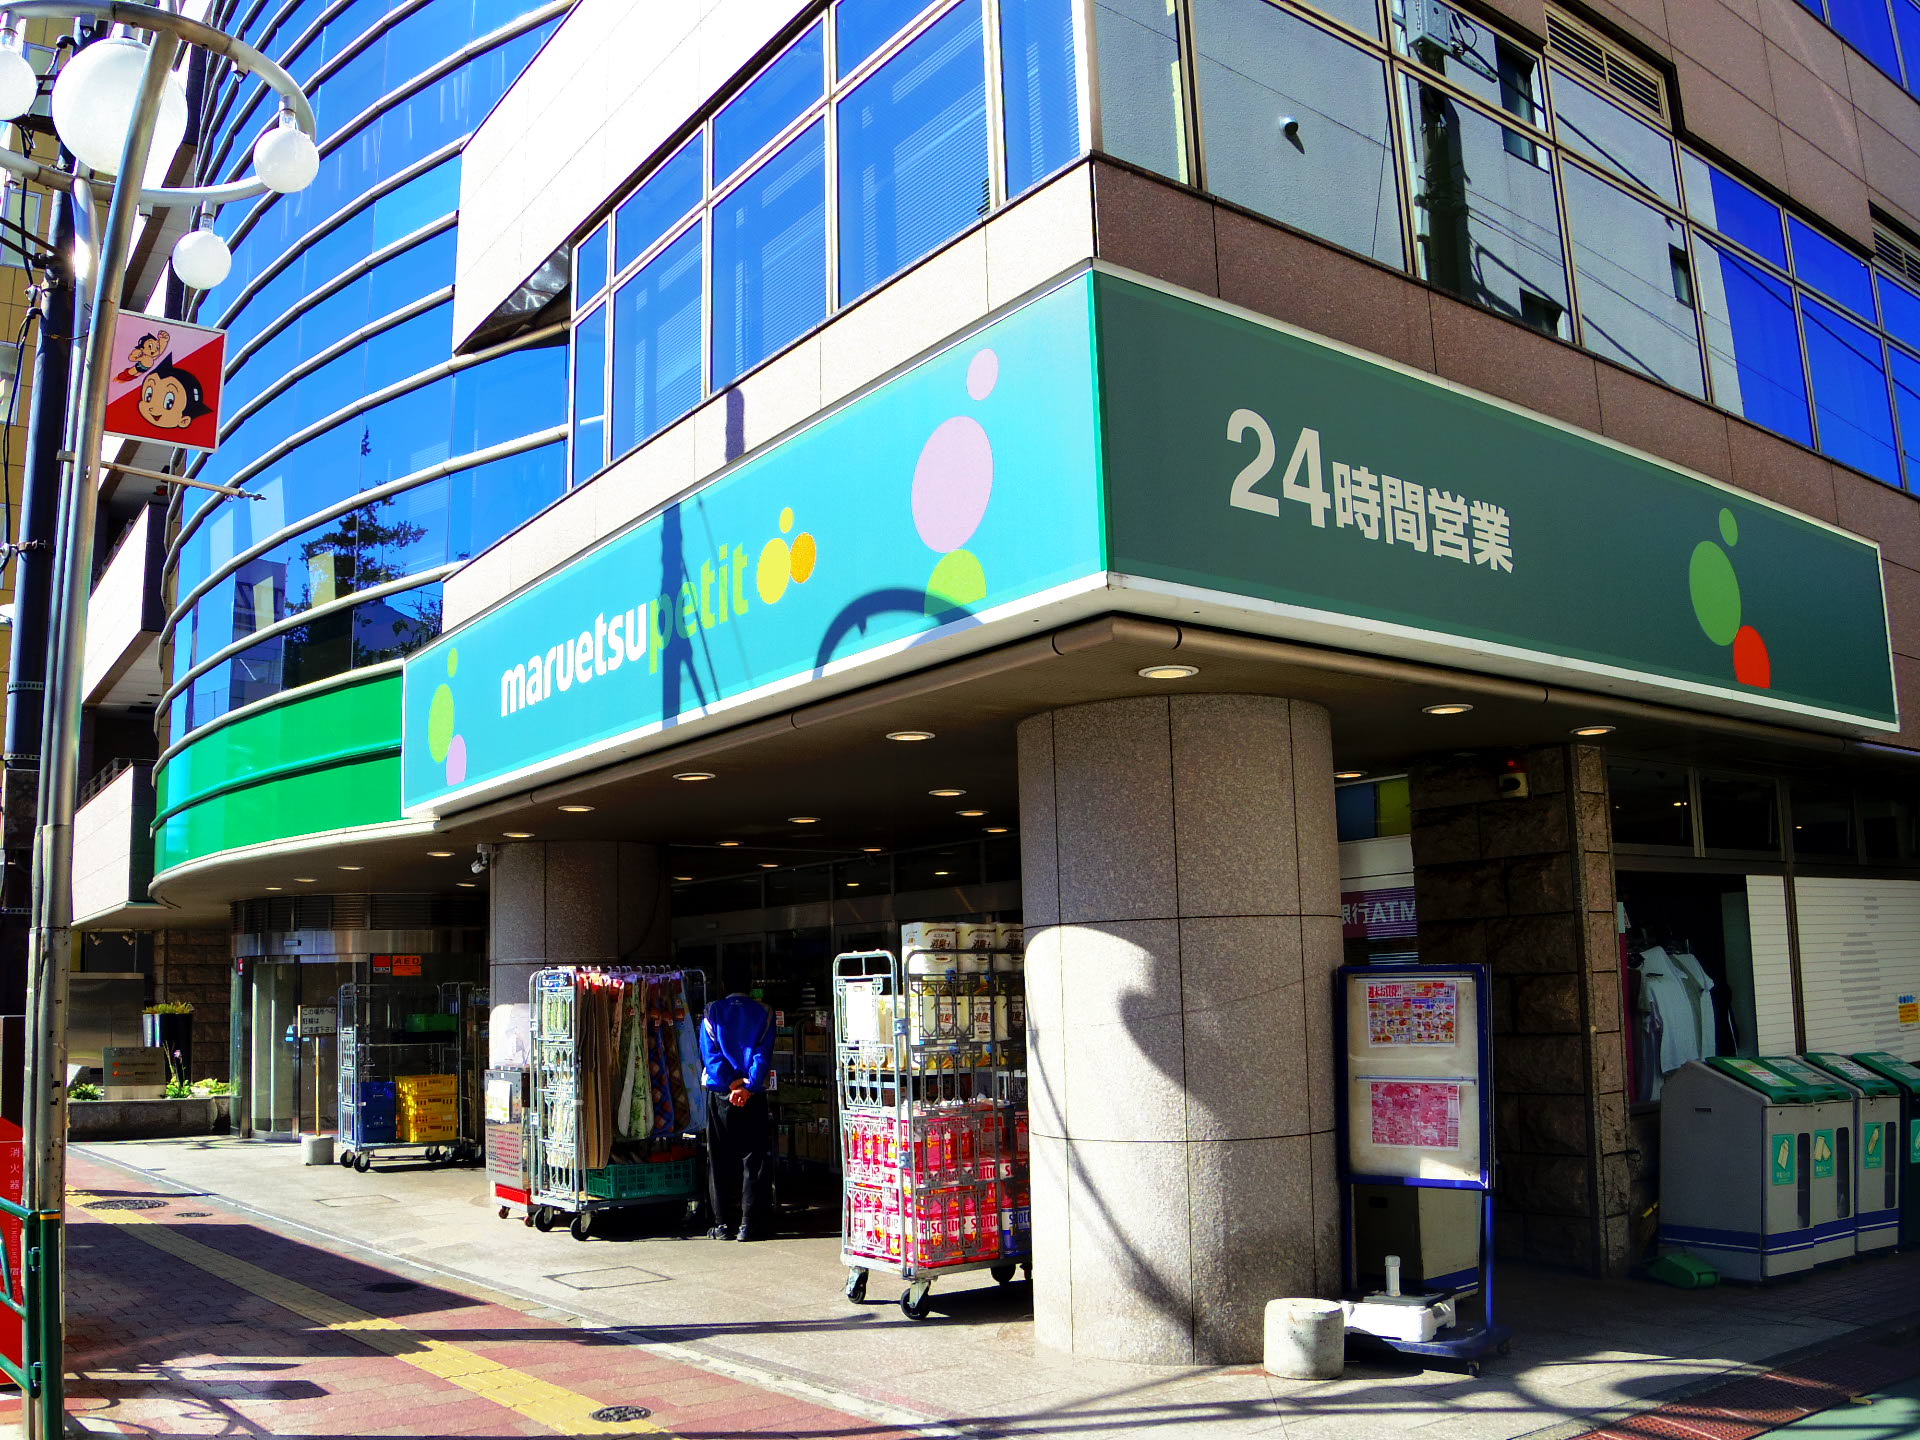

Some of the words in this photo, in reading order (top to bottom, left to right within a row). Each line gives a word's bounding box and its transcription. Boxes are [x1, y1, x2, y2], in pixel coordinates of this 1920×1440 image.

[1226, 408, 1514, 573] 24時間営業
[501, 603, 647, 717] maruetsu
[649, 543, 748, 675] petit
[394, 957, 420, 965] AED
[10, 1147, 20, 1190] 消火器
